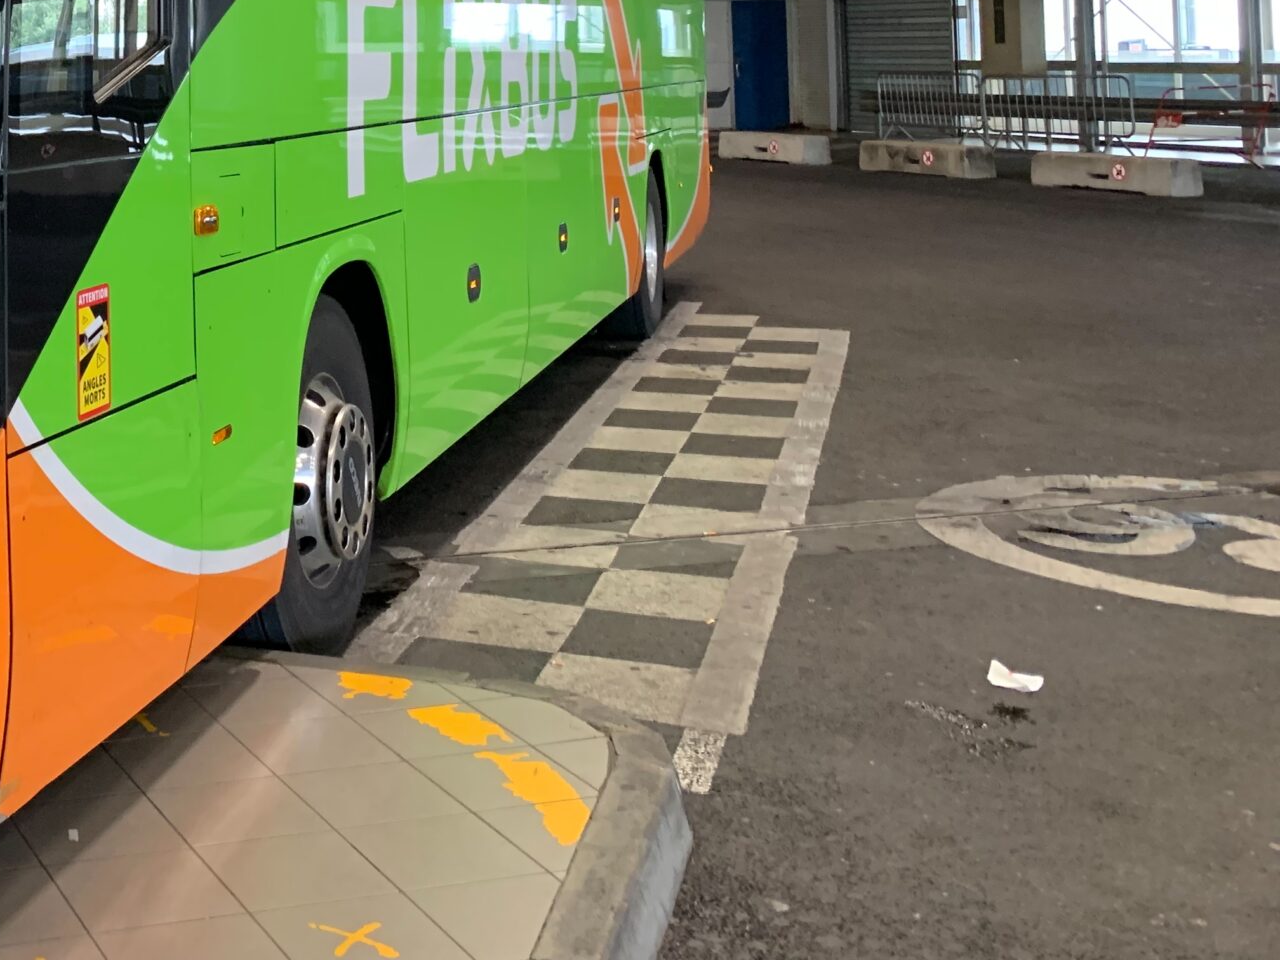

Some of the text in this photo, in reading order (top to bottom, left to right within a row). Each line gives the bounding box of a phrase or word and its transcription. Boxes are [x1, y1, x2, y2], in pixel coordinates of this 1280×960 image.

[78, 286, 108, 306] ATTENTION
[83, 372, 106, 394] ANGLES
[84, 387, 106, 407] MORTS
